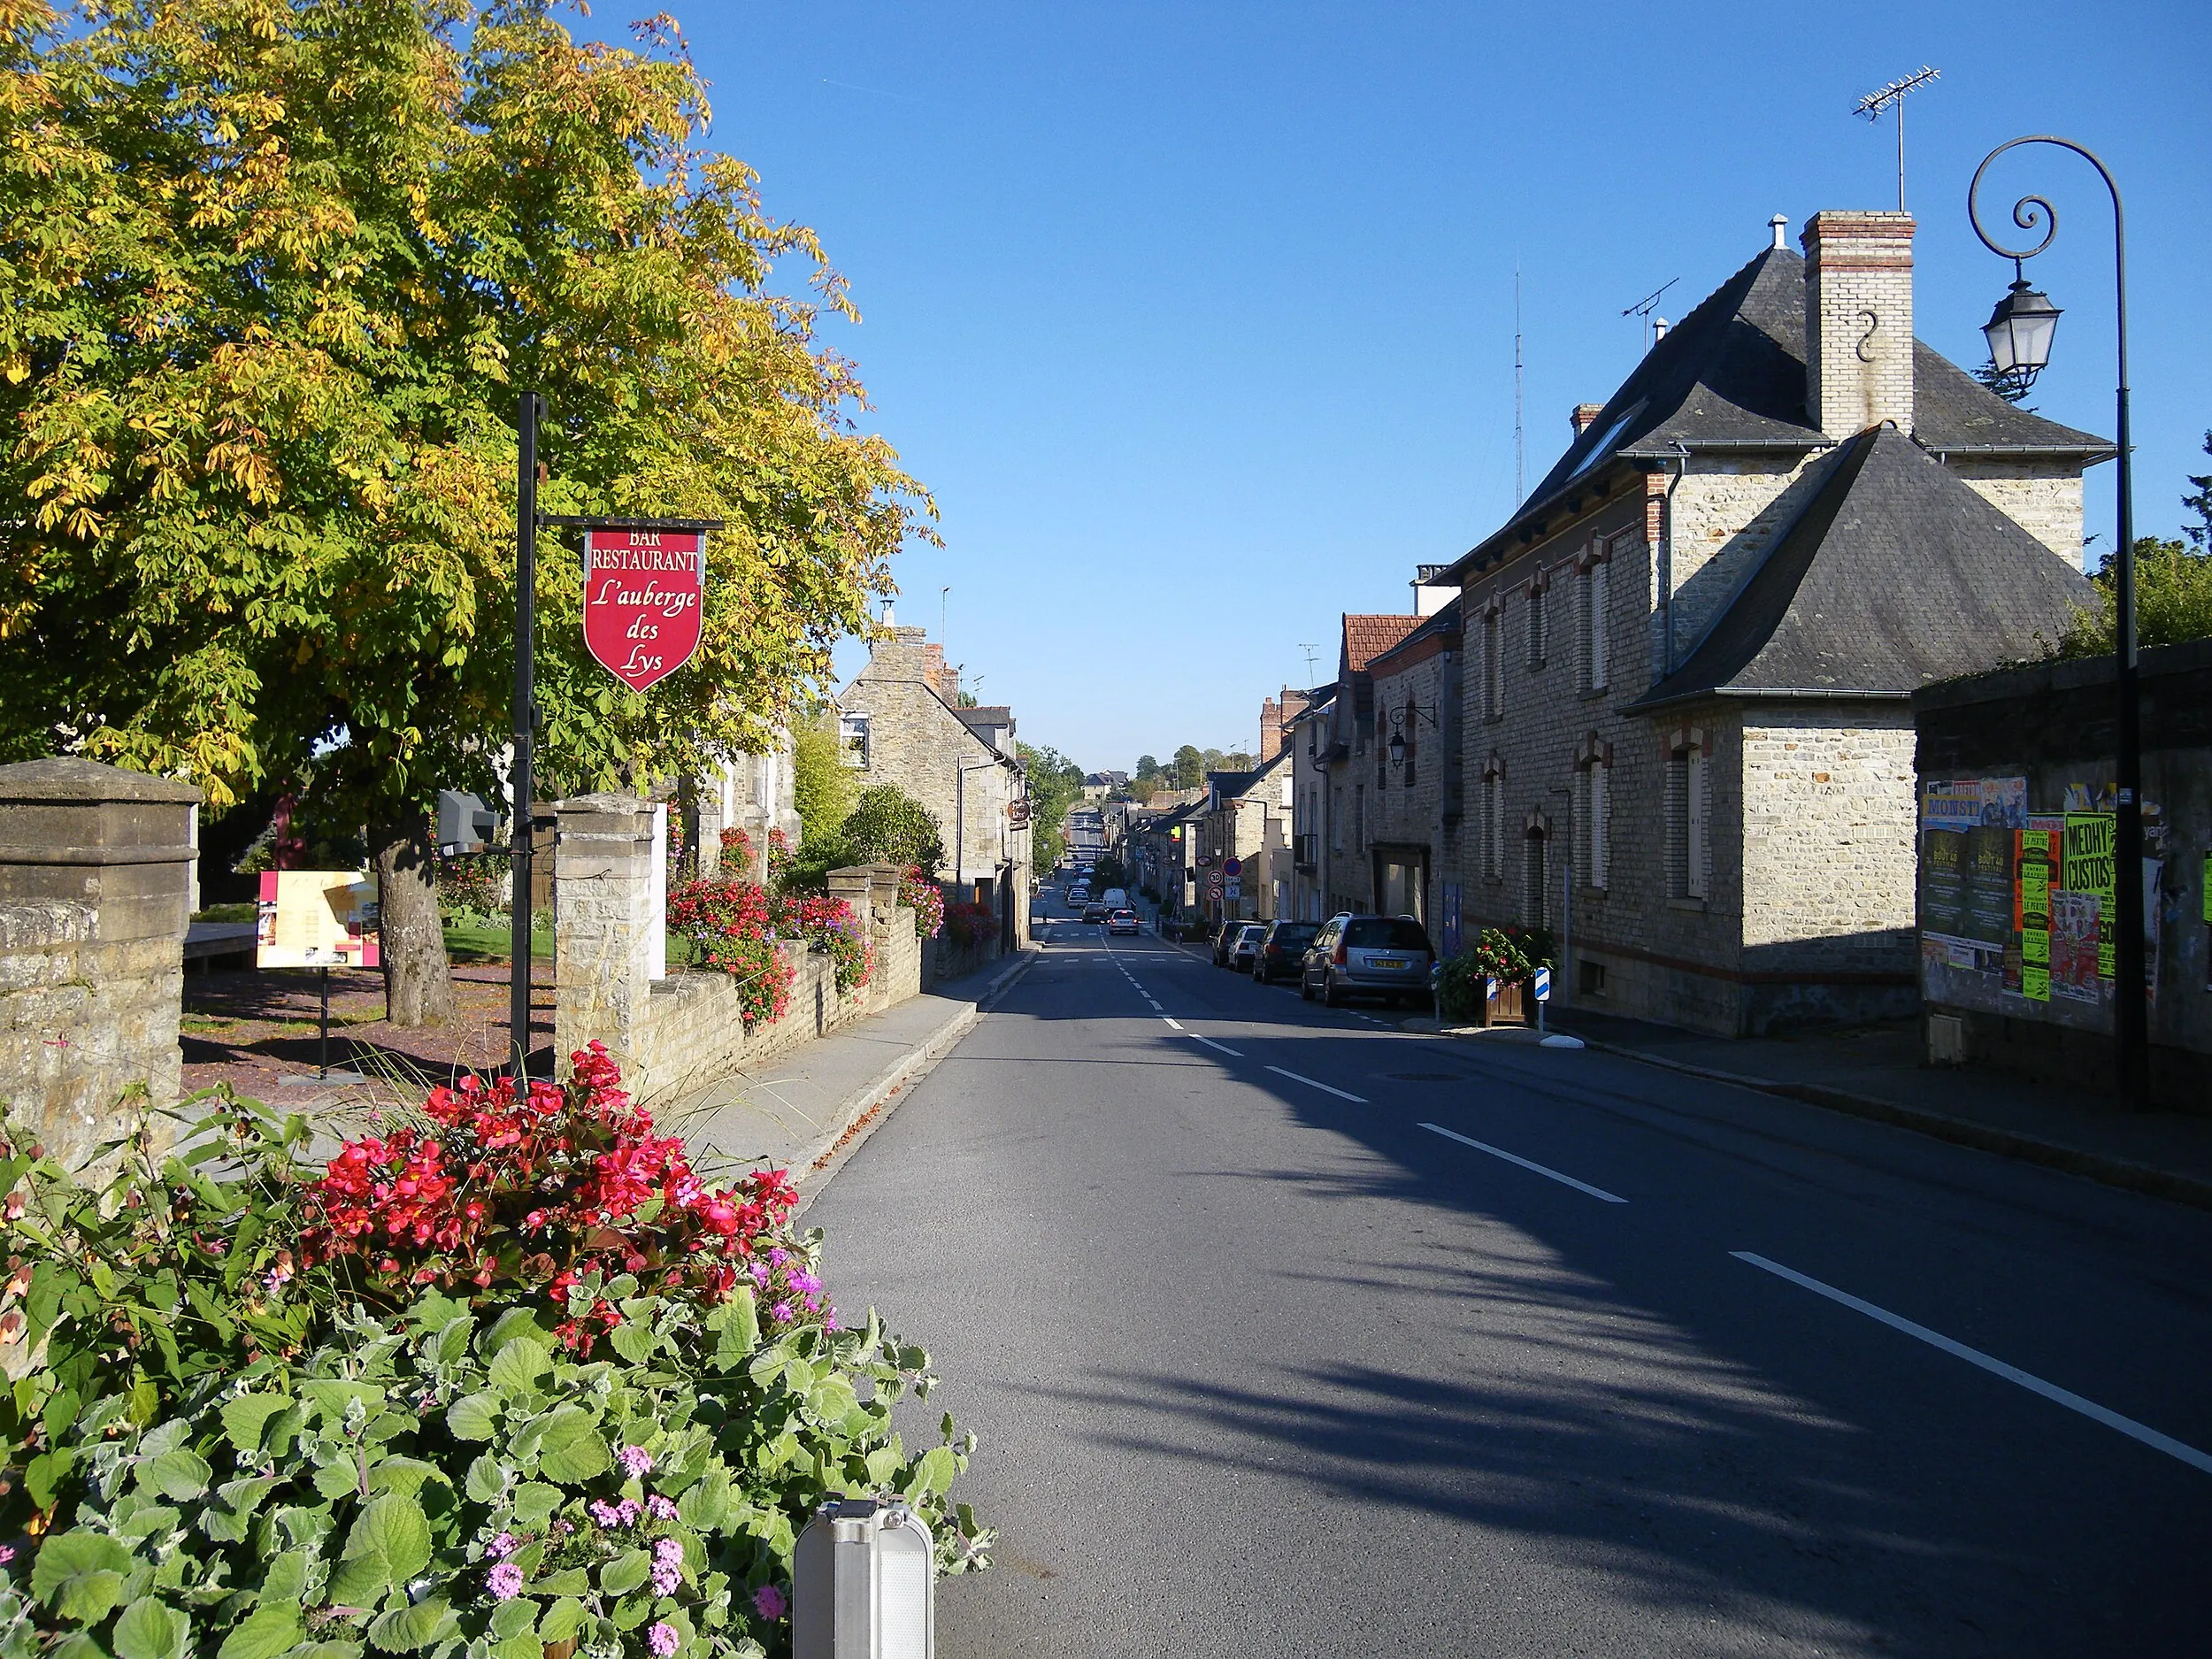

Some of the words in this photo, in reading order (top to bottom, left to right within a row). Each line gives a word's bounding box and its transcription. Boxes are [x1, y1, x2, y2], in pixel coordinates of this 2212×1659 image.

[629, 528, 662, 547] BAR
[592, 549, 697, 572] RESTAURANT
[591, 579, 696, 618] L'auberge
[626, 614, 659, 640] des
[620, 643, 664, 678] Lys
[2068, 820, 2108, 856] MEDHY
[2068, 856, 2110, 891] CUSTOS
